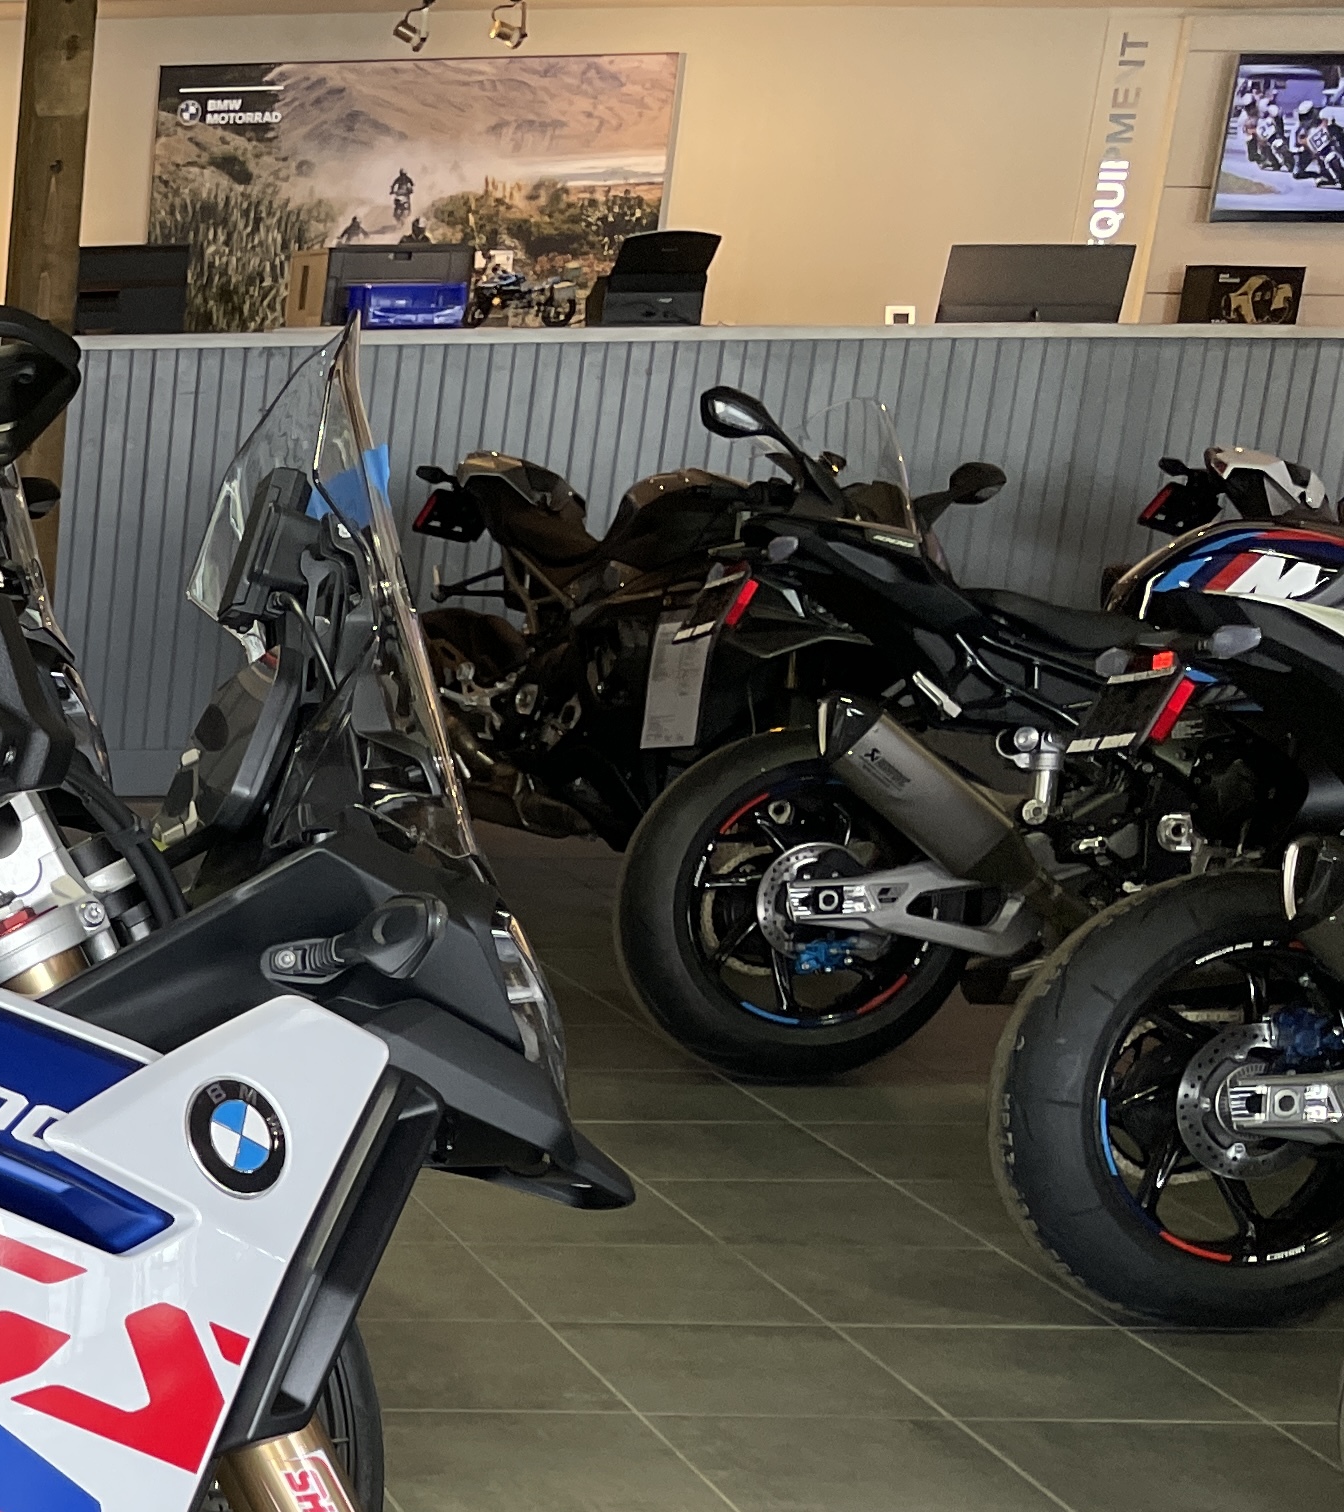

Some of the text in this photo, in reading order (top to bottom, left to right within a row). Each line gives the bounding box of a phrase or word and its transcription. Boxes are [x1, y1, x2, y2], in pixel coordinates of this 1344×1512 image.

[207, 99, 242, 111] BMW
[206, 111, 282, 125] MOTORRAD
[1088, 32, 1149, 244] QUIPMENT
